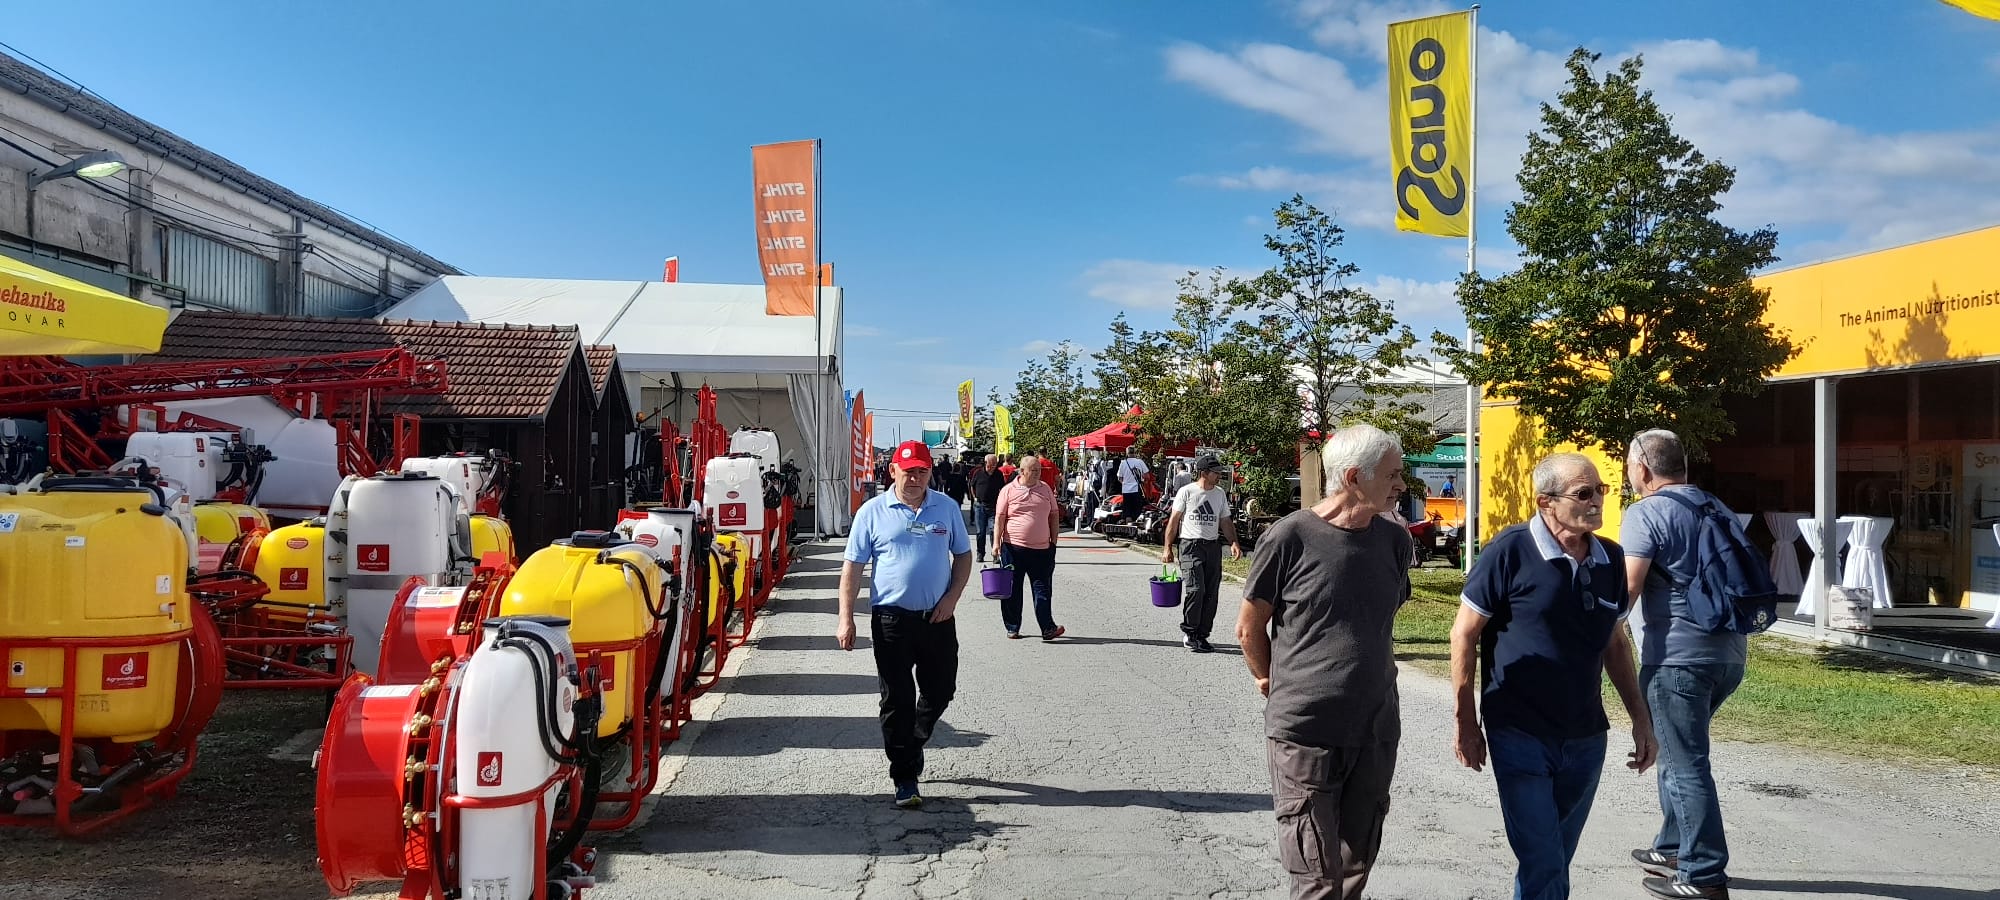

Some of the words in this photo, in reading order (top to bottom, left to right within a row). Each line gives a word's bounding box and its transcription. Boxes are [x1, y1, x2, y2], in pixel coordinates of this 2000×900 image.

[0, 285, 66, 313] ehanika
[1840, 311, 1862, 328] The
[1864, 302, 1911, 324] Animal
[1914, 290, 2000, 317] Nutritionist
[853, 413, 865, 493] STIHL
